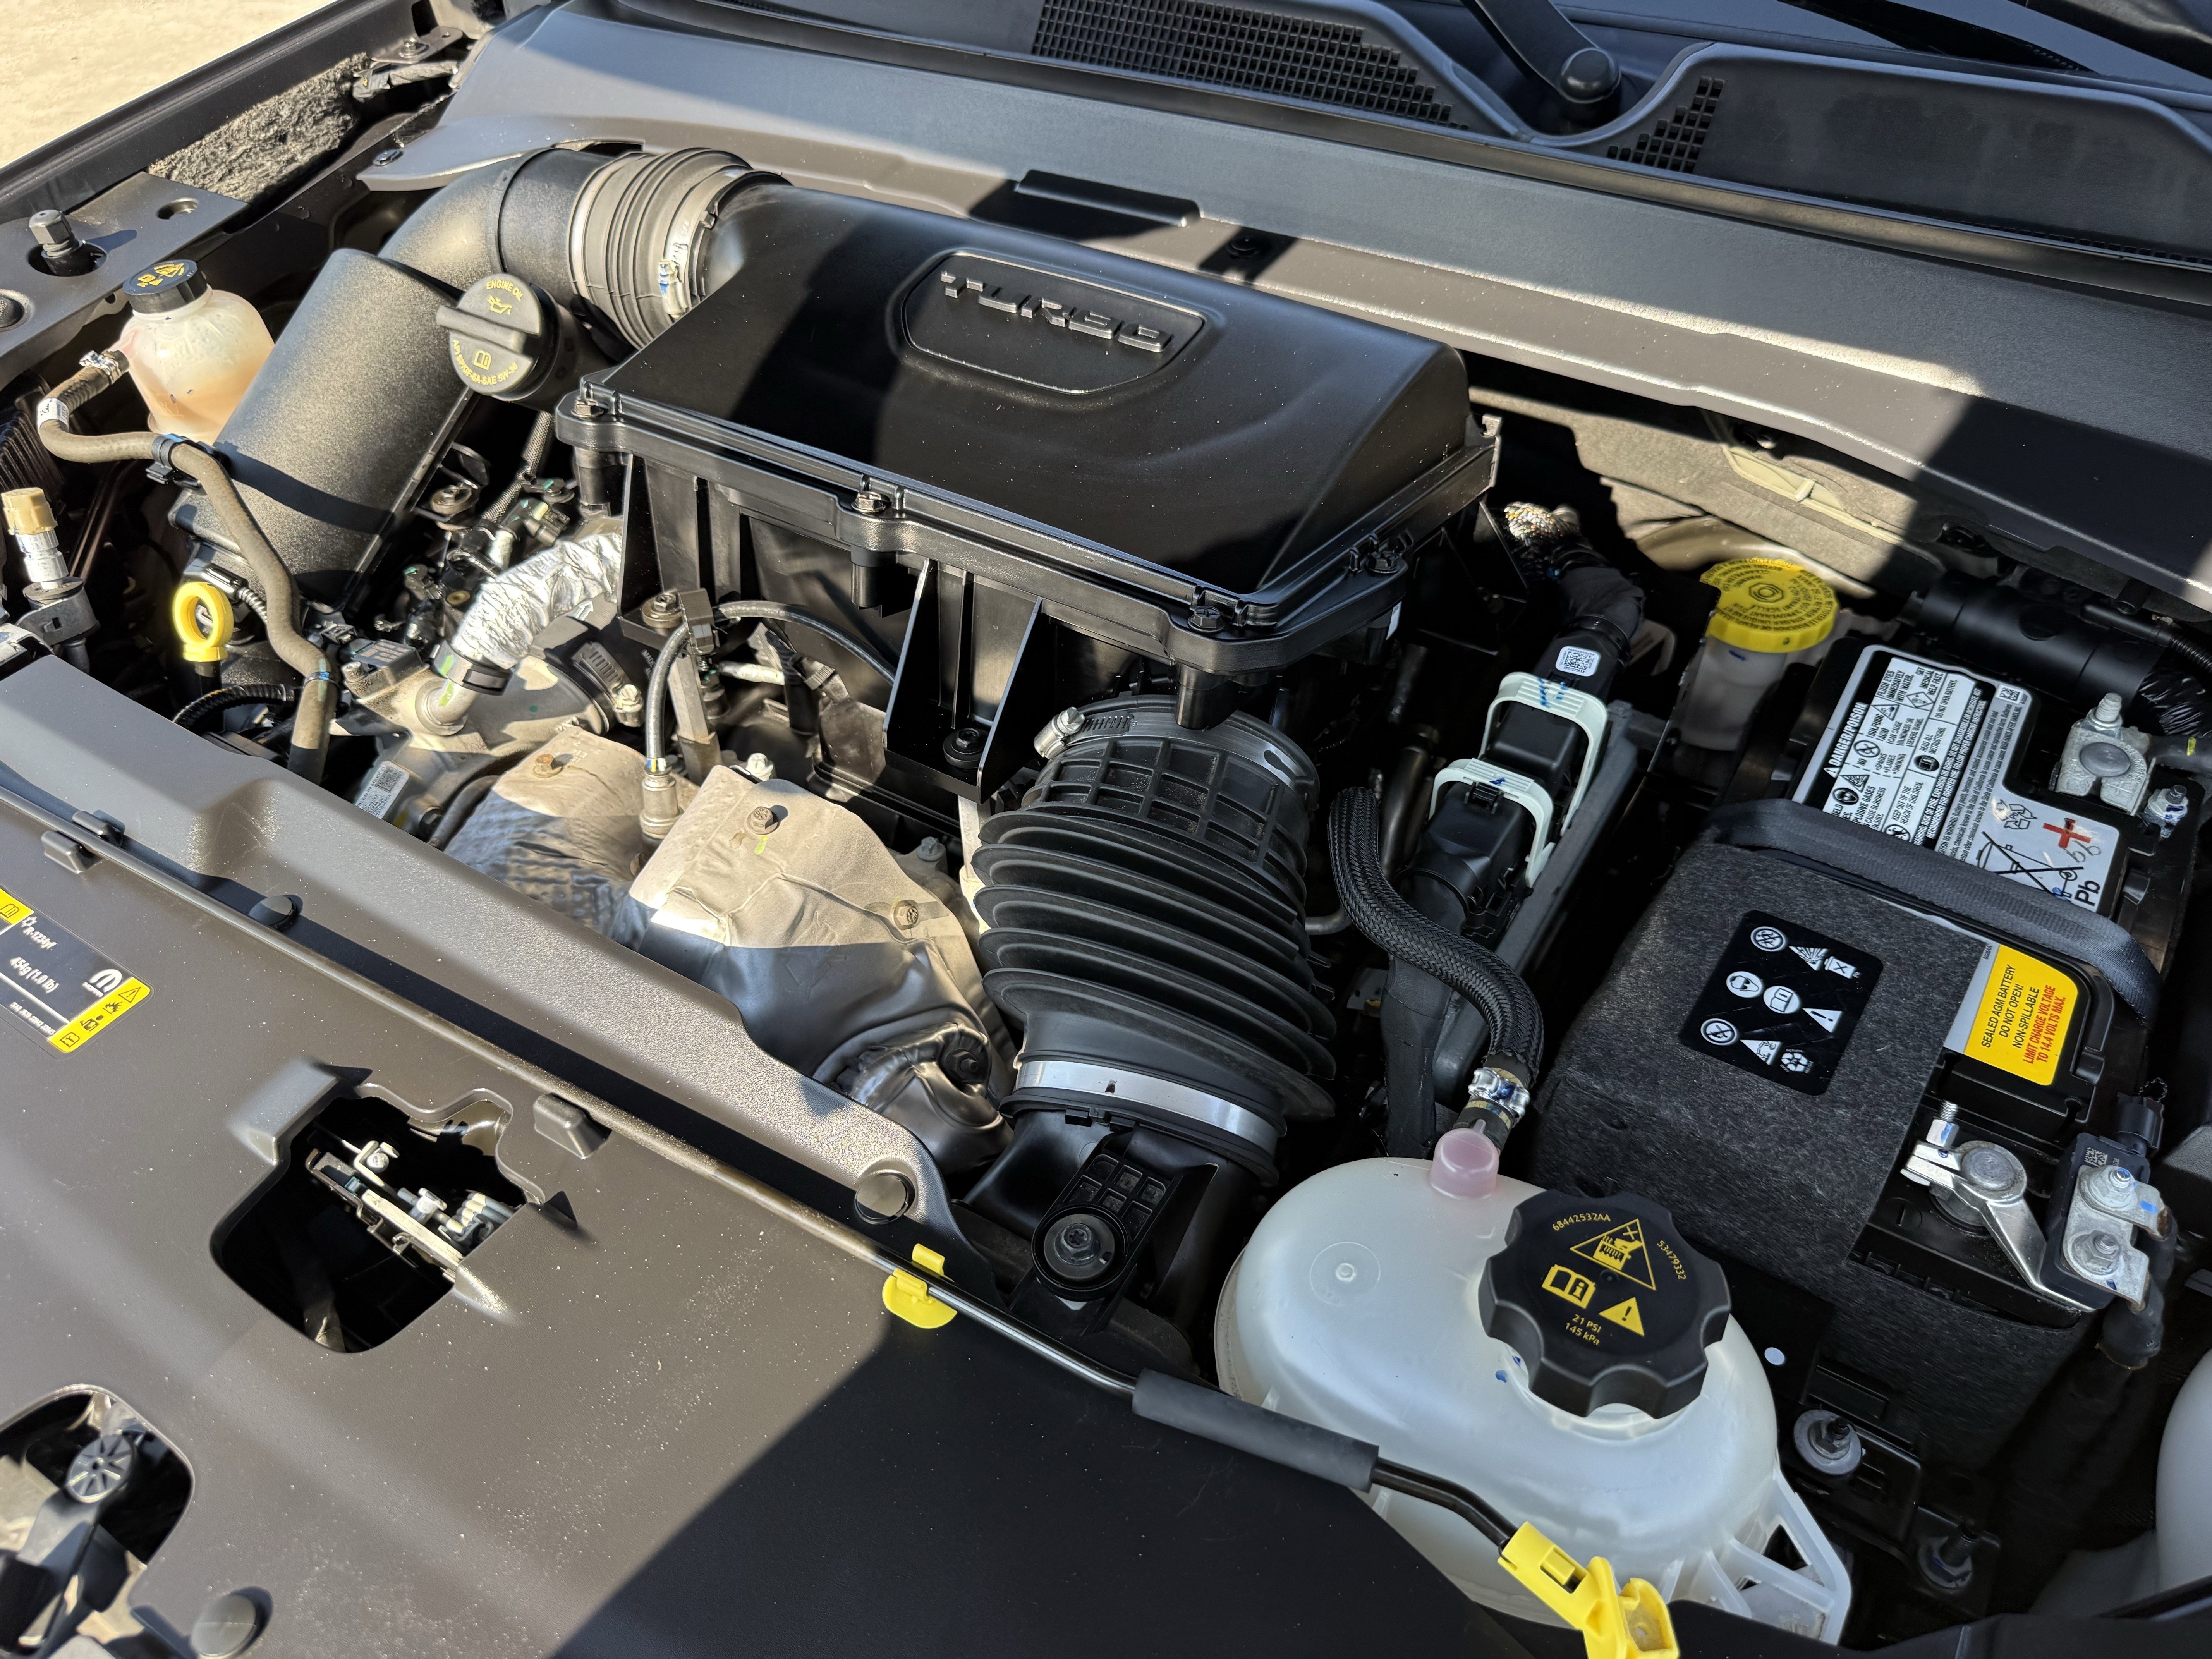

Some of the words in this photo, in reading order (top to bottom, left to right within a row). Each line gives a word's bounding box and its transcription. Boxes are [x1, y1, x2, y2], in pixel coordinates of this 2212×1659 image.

[486, 279, 514, 292] ENGINE
[513, 287, 524, 302] OIL
[941, 271, 1172, 353] TURBO
[642, 650, 656, 667] MADE
[1915, 666, 1925, 675] GET
[1877, 682, 1889, 696] FLUSH
[1883, 670, 1895, 682] EYES
[1887, 670, 1905, 699] IMMEDIATELY
[1896, 690, 1906, 702] WITH
[1901, 675, 1914, 690] WATER.
[1919, 670, 1934, 688] MEDICAL
[1927, 684, 1938, 696] HELP
[1829, 703, 1866, 766] DANGER/POISON
[1868, 714, 1884, 736] SULFURIC
[1878, 728, 1889, 740] ACID
[1891, 721, 1902, 734] CAUSE
[1887, 733, 1897, 742] CAN
[1919, 741, 1930, 752] READ
[1927, 727, 1946, 754] INSTRUCTIONS.
[1852, 802, 1869, 824] PLOSIVE
[1862, 785, 1876, 802] GASES
[1864, 809, 1876, 823] CAUSE
[1870, 787, 1886, 810] BLINDNESS
[1891, 809, 1901, 821] KEEP
[1896, 800, 1905, 810] OUT
[1901, 785, 1911, 795] THE
[1900, 809, 1912, 825] REACH
[1908, 782, 1923, 804] CHILDREN.
[1921, 814, 1932, 826] RISK
[1932, 776, 1947, 798] EXPLOSION
[1926, 805, 1945, 838] RECOMMENDED
[1939, 796, 1949, 806] FOR
[2074, 879, 2101, 907] Pb
[9, 957, 31, 976] 454g
[26, 969, 46, 985] (1.0
[42, 975, 60, 994] lb)
[1997, 964, 2015, 998] BATTERY
[1992, 998, 2005, 1017] AGM
[2008, 983, 2024, 1008] OPEN!
[2037, 985, 2056, 1015] VOLTAGE
[2051, 996, 2066, 1014] MAX.
[2002, 1007, 2015, 1025] NOT
[2013, 987, 2039, 1048] NON-SPILLABLE
[2044, 1013, 2060, 1036] VOLTS
[1981, 1017, 1999, 1048] SEALED
[1999, 1025, 2010, 1038] DO
[2029, 1015, 2046, 1043] CHARGE
[2023, 1042, 2038, 1064] LIMIT
[2040, 1036, 2053, 1051] 14.4
[2036, 1052, 2049, 1062] TO
[1552, 1212, 1611, 1231] 68442532AA
[1656, 1240, 1687, 1281] 53479332
[1565, 1322, 1582, 1337] 145
[1583, 1330, 1601, 1346] kPa
[1571, 1314, 1585, 1324] 21
[1586, 1319, 1602, 1333] PSI
